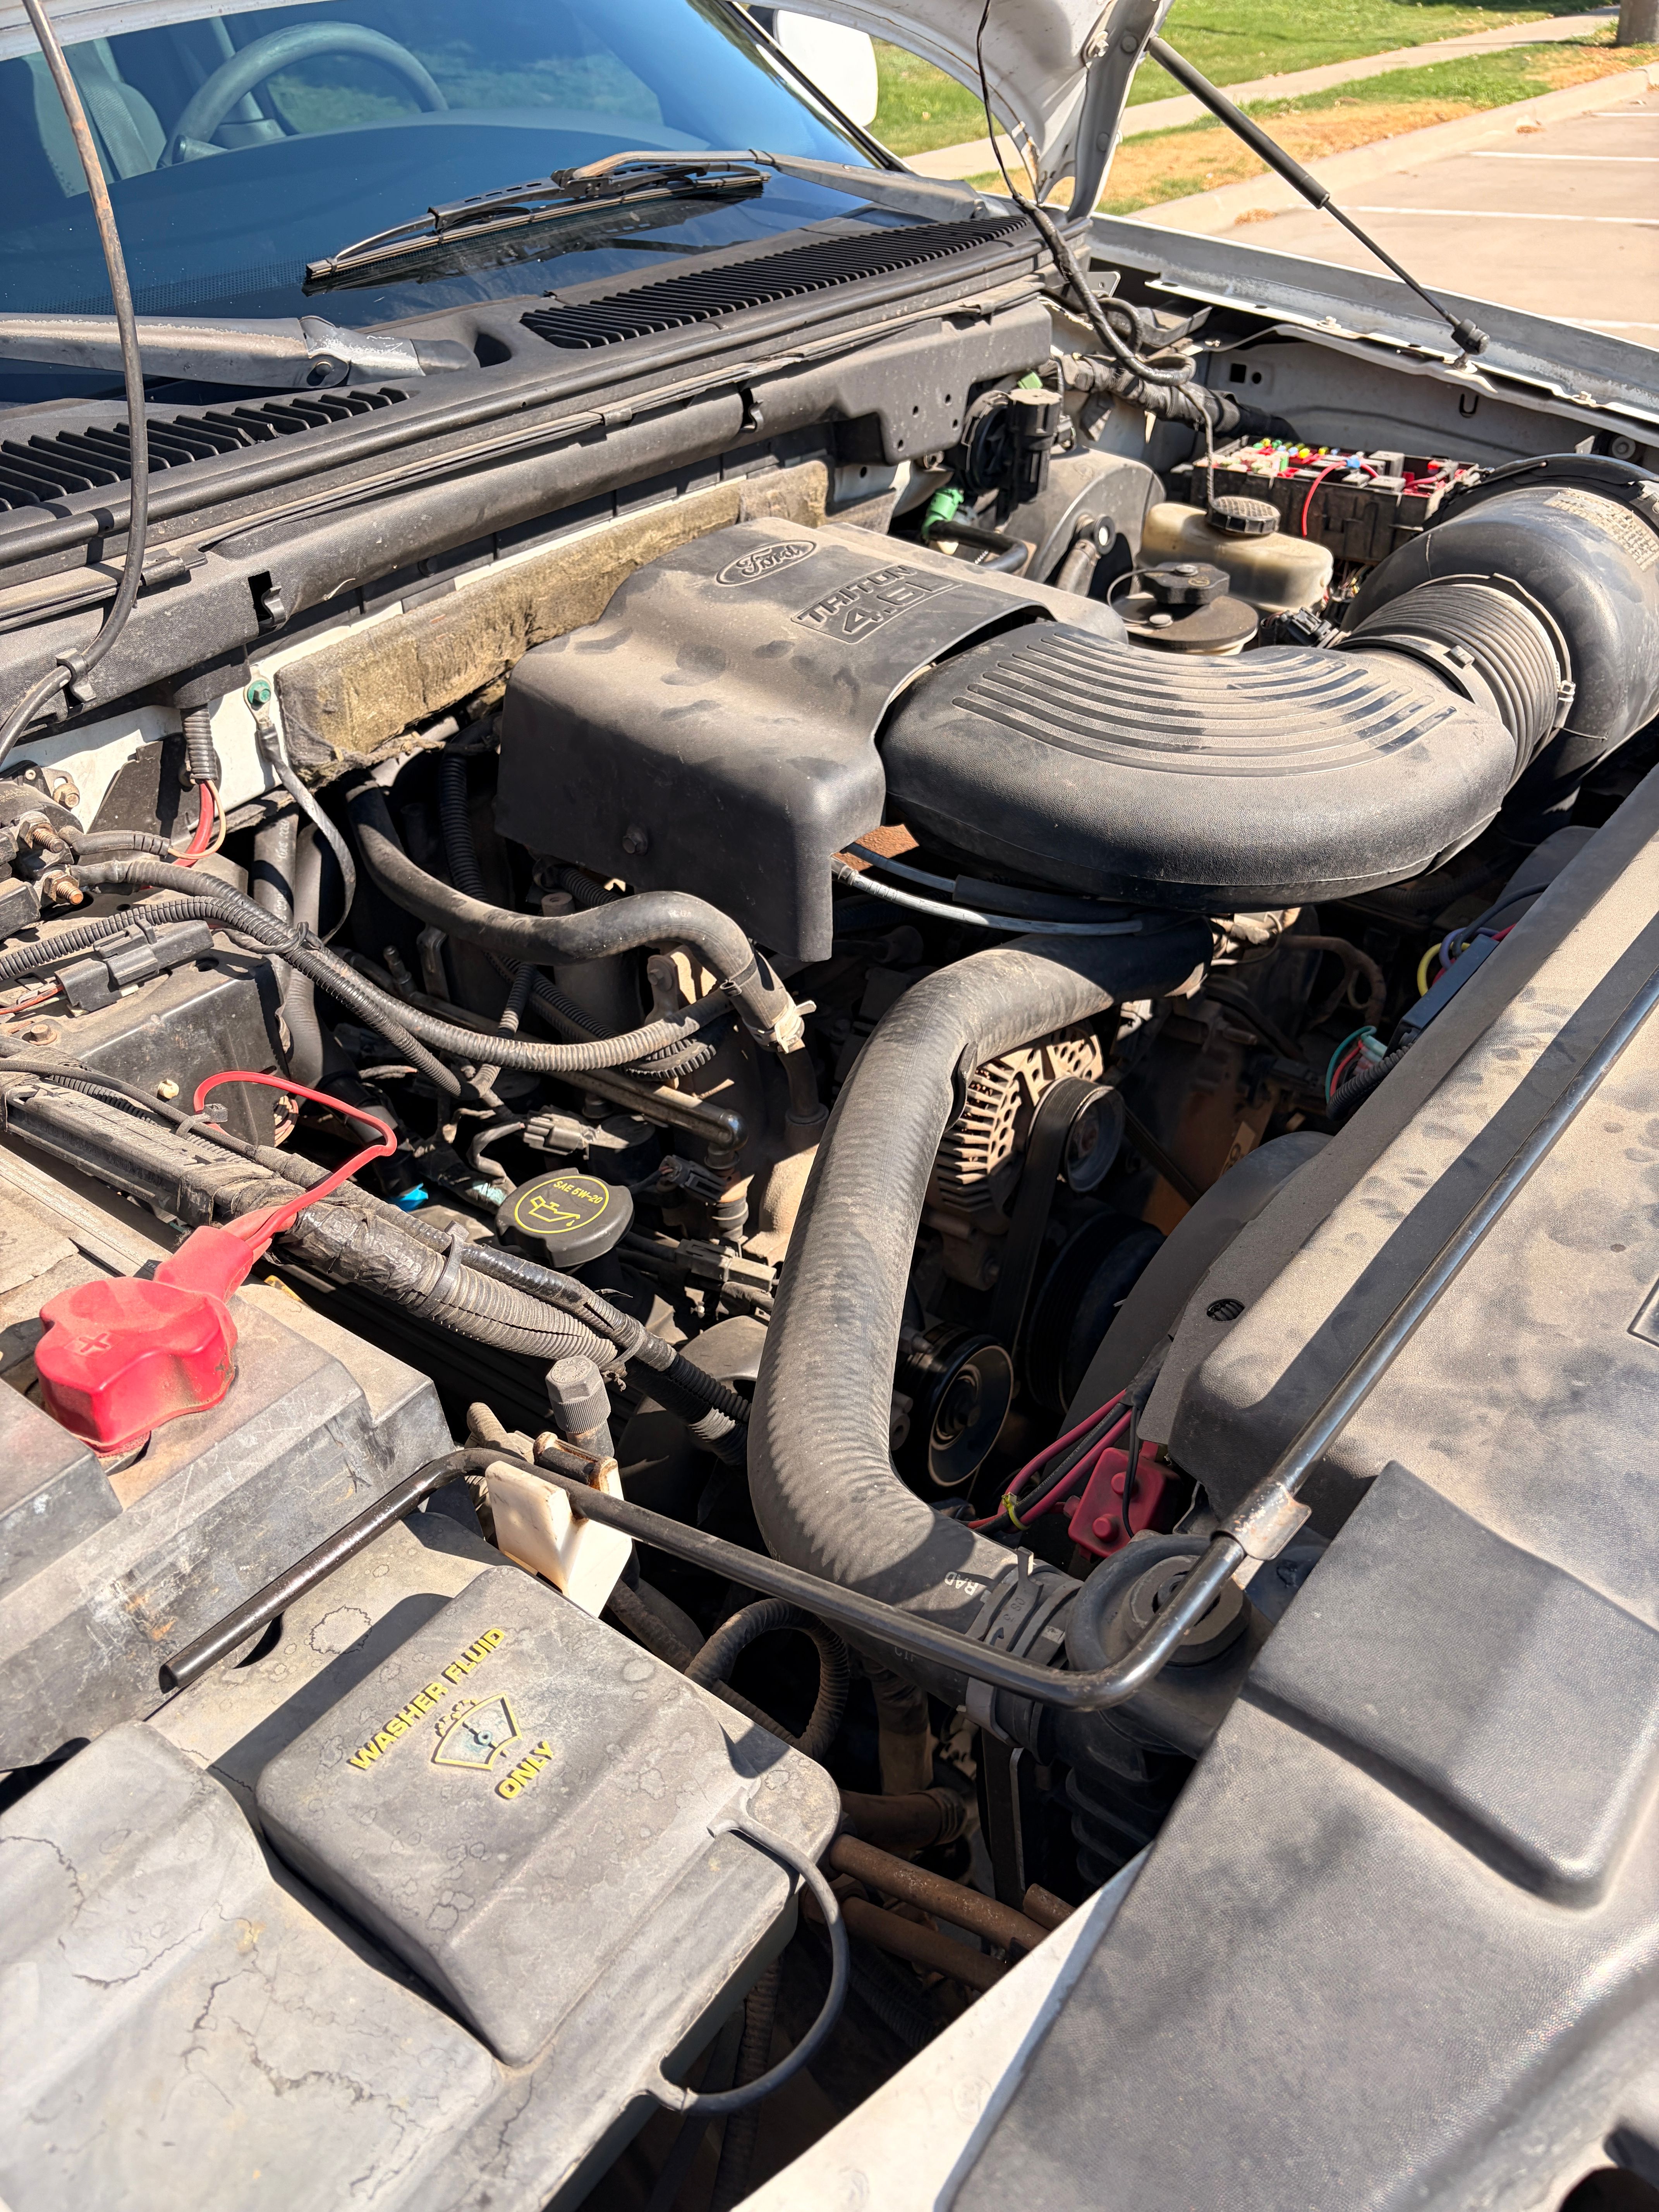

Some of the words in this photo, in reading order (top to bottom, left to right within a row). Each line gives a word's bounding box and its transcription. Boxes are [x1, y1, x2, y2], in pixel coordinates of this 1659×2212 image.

[736, 544, 800, 577] Ford
[797, 564, 917, 623] TRITON
[843, 581, 953, 634] 4.6L
[66, 1094, 112, 1113] LINK
[69, 1109, 143, 1141] FUSIBLE
[138, 1142, 186, 1163] LINK
[106, 1113, 186, 1148] FUSIBLE
[554, 1181, 574, 1192] SAE
[572, 1188, 603, 1204] 5W-20
[944, 1571, 979, 1595] RAD
[350, 1681, 449, 1770] WASHER
[445, 1628, 505, 1685] FLUID
[498, 1740, 555, 1799] ONLY
